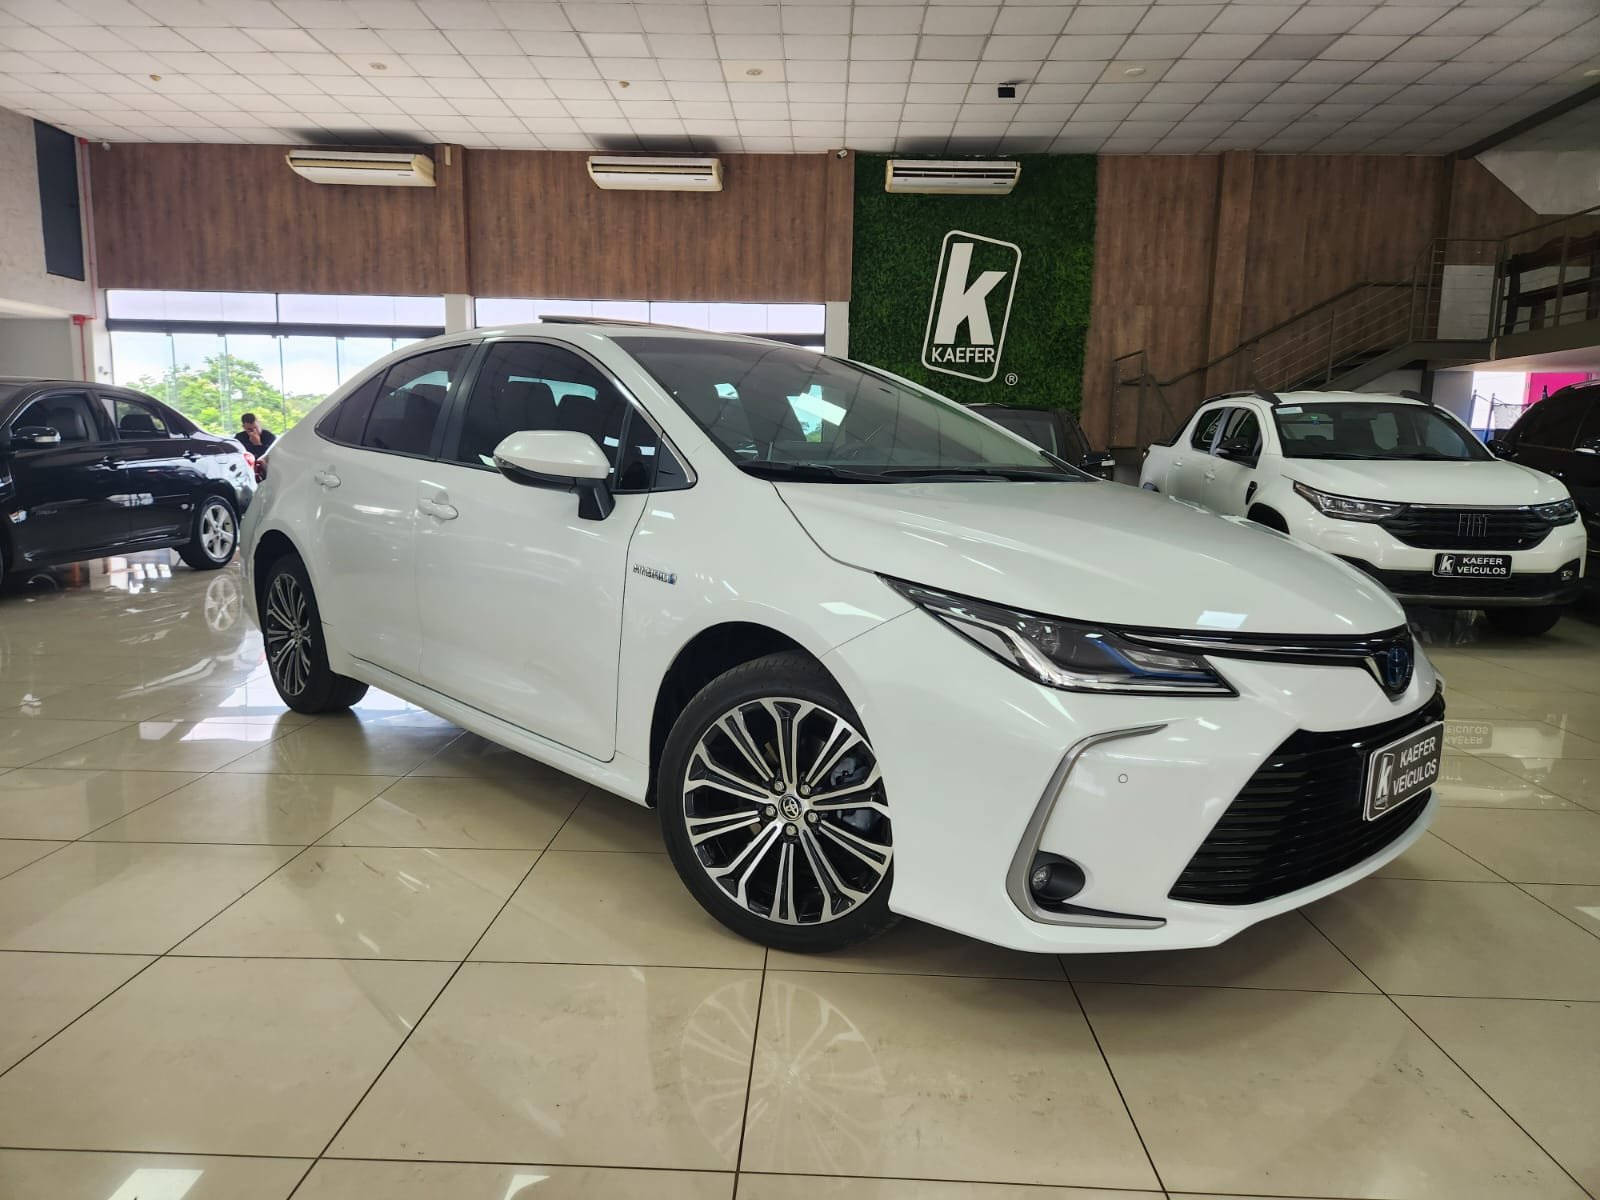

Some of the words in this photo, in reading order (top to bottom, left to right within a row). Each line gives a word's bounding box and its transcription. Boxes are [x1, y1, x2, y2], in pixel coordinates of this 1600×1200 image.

[931, 346, 996, 363] KAEFER
[1462, 556, 1503, 565] KAEFER
[1456, 565, 1507, 575] VEÍCULOS
[1400, 735, 1436, 769] KAEFER
[1393, 758, 1437, 796] VEÍCULOS
